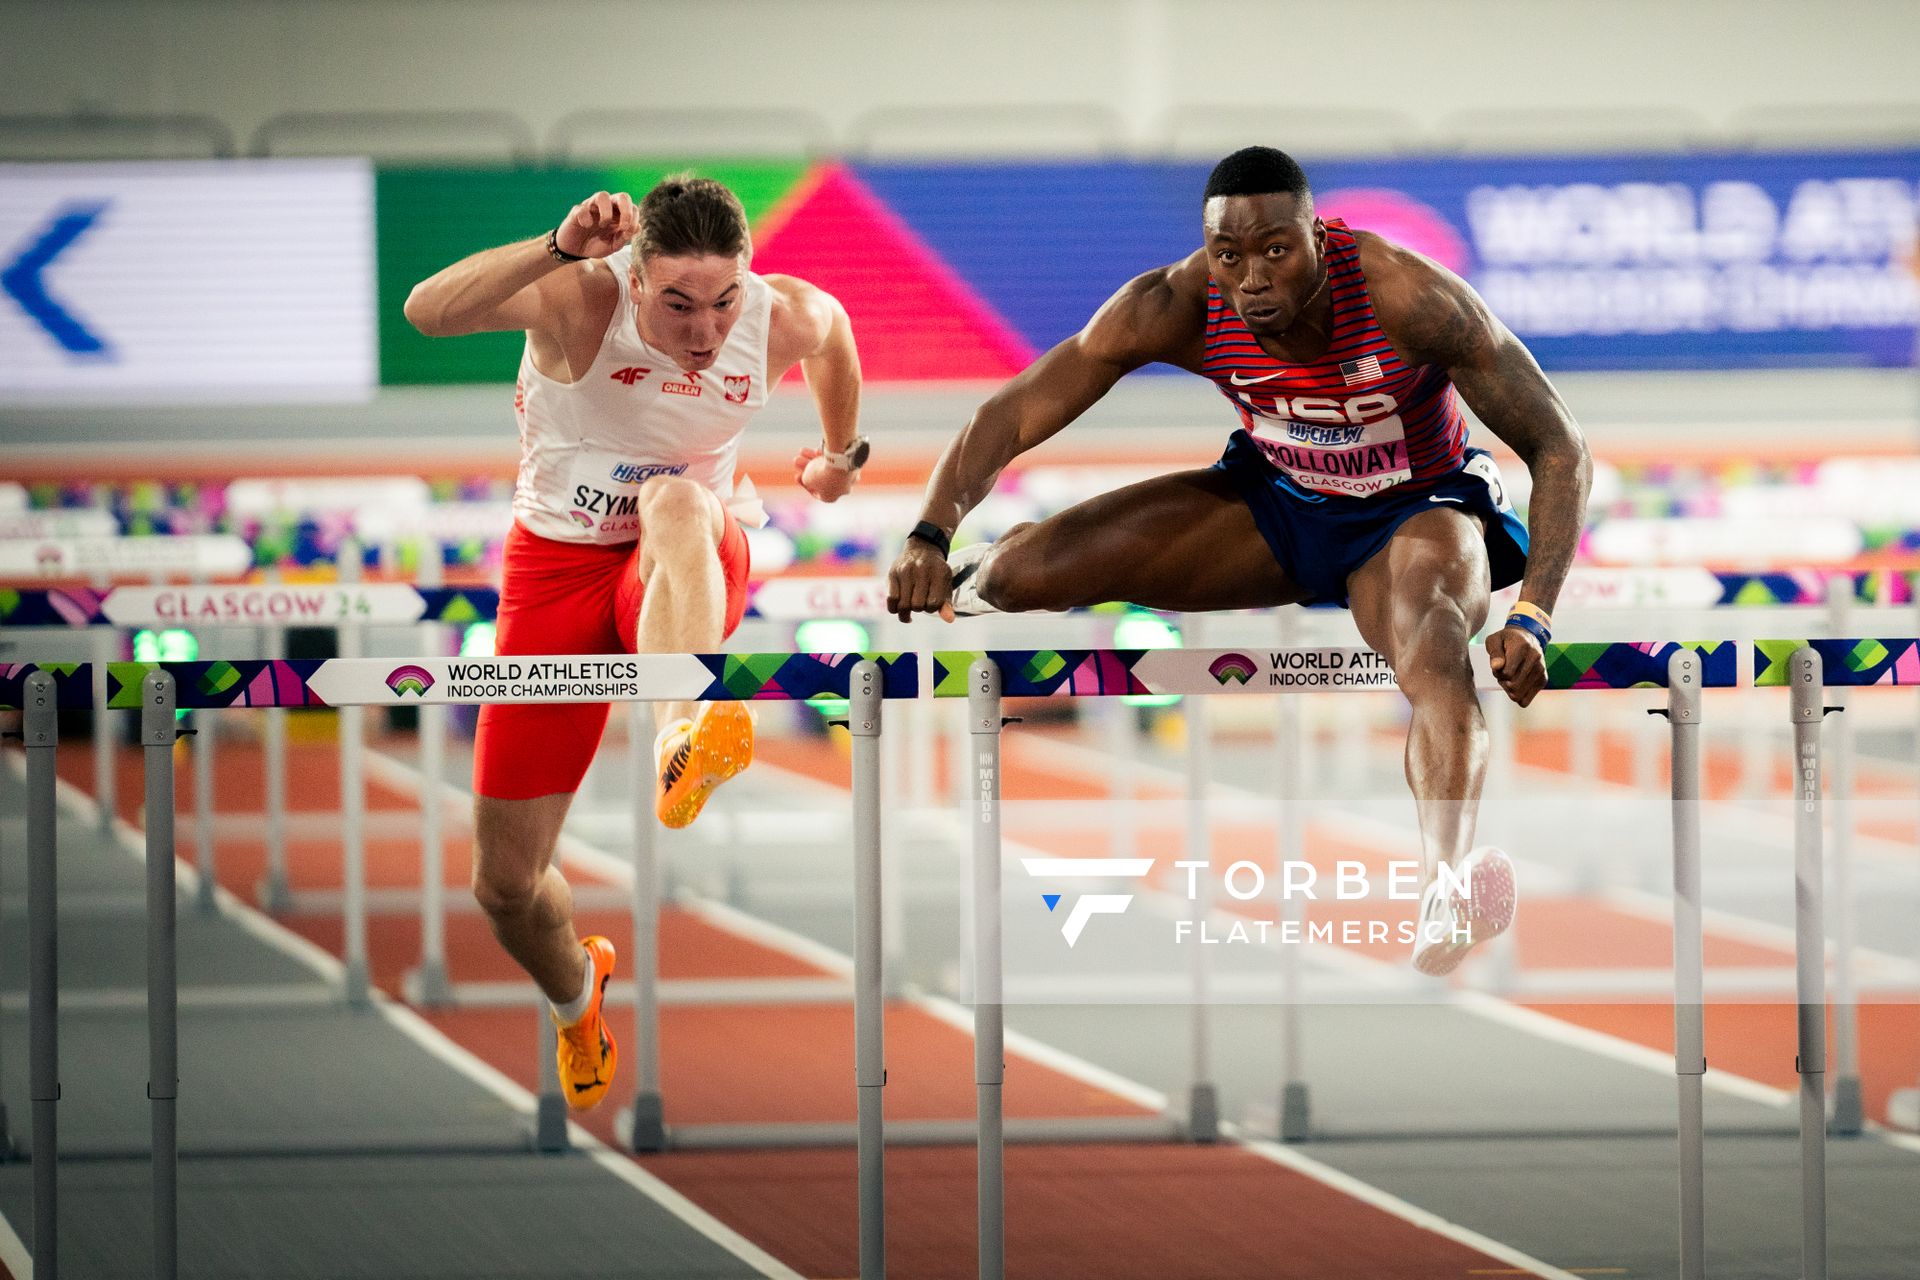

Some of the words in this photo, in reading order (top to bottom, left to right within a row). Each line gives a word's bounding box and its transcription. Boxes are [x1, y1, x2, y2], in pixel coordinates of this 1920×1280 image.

[611, 367, 651, 386] 4F
[663, 383, 701, 396] ORLEN
[1239, 391, 1398, 424] USA
[1261, 440, 1398, 478] HOLLOWAY
[1299, 475, 1382, 493] GLASGOW
[573, 484, 640, 516] SZYM
[155, 593, 325, 619] GLASGOW
[1271, 652, 1344, 669] WORLD
[1349, 652, 1389, 669] ATH
[448, 664, 521, 681] WORLD
[527, 662, 638, 680] ATHLETICS
[1270, 673, 1329, 686] INDOOR
[447, 684, 506, 698] INDOOR
[511, 682, 638, 697] CHAMPIONSHIPS
[1802, 758, 1816, 813] MONDO
[979, 768, 993, 823] MONDO
